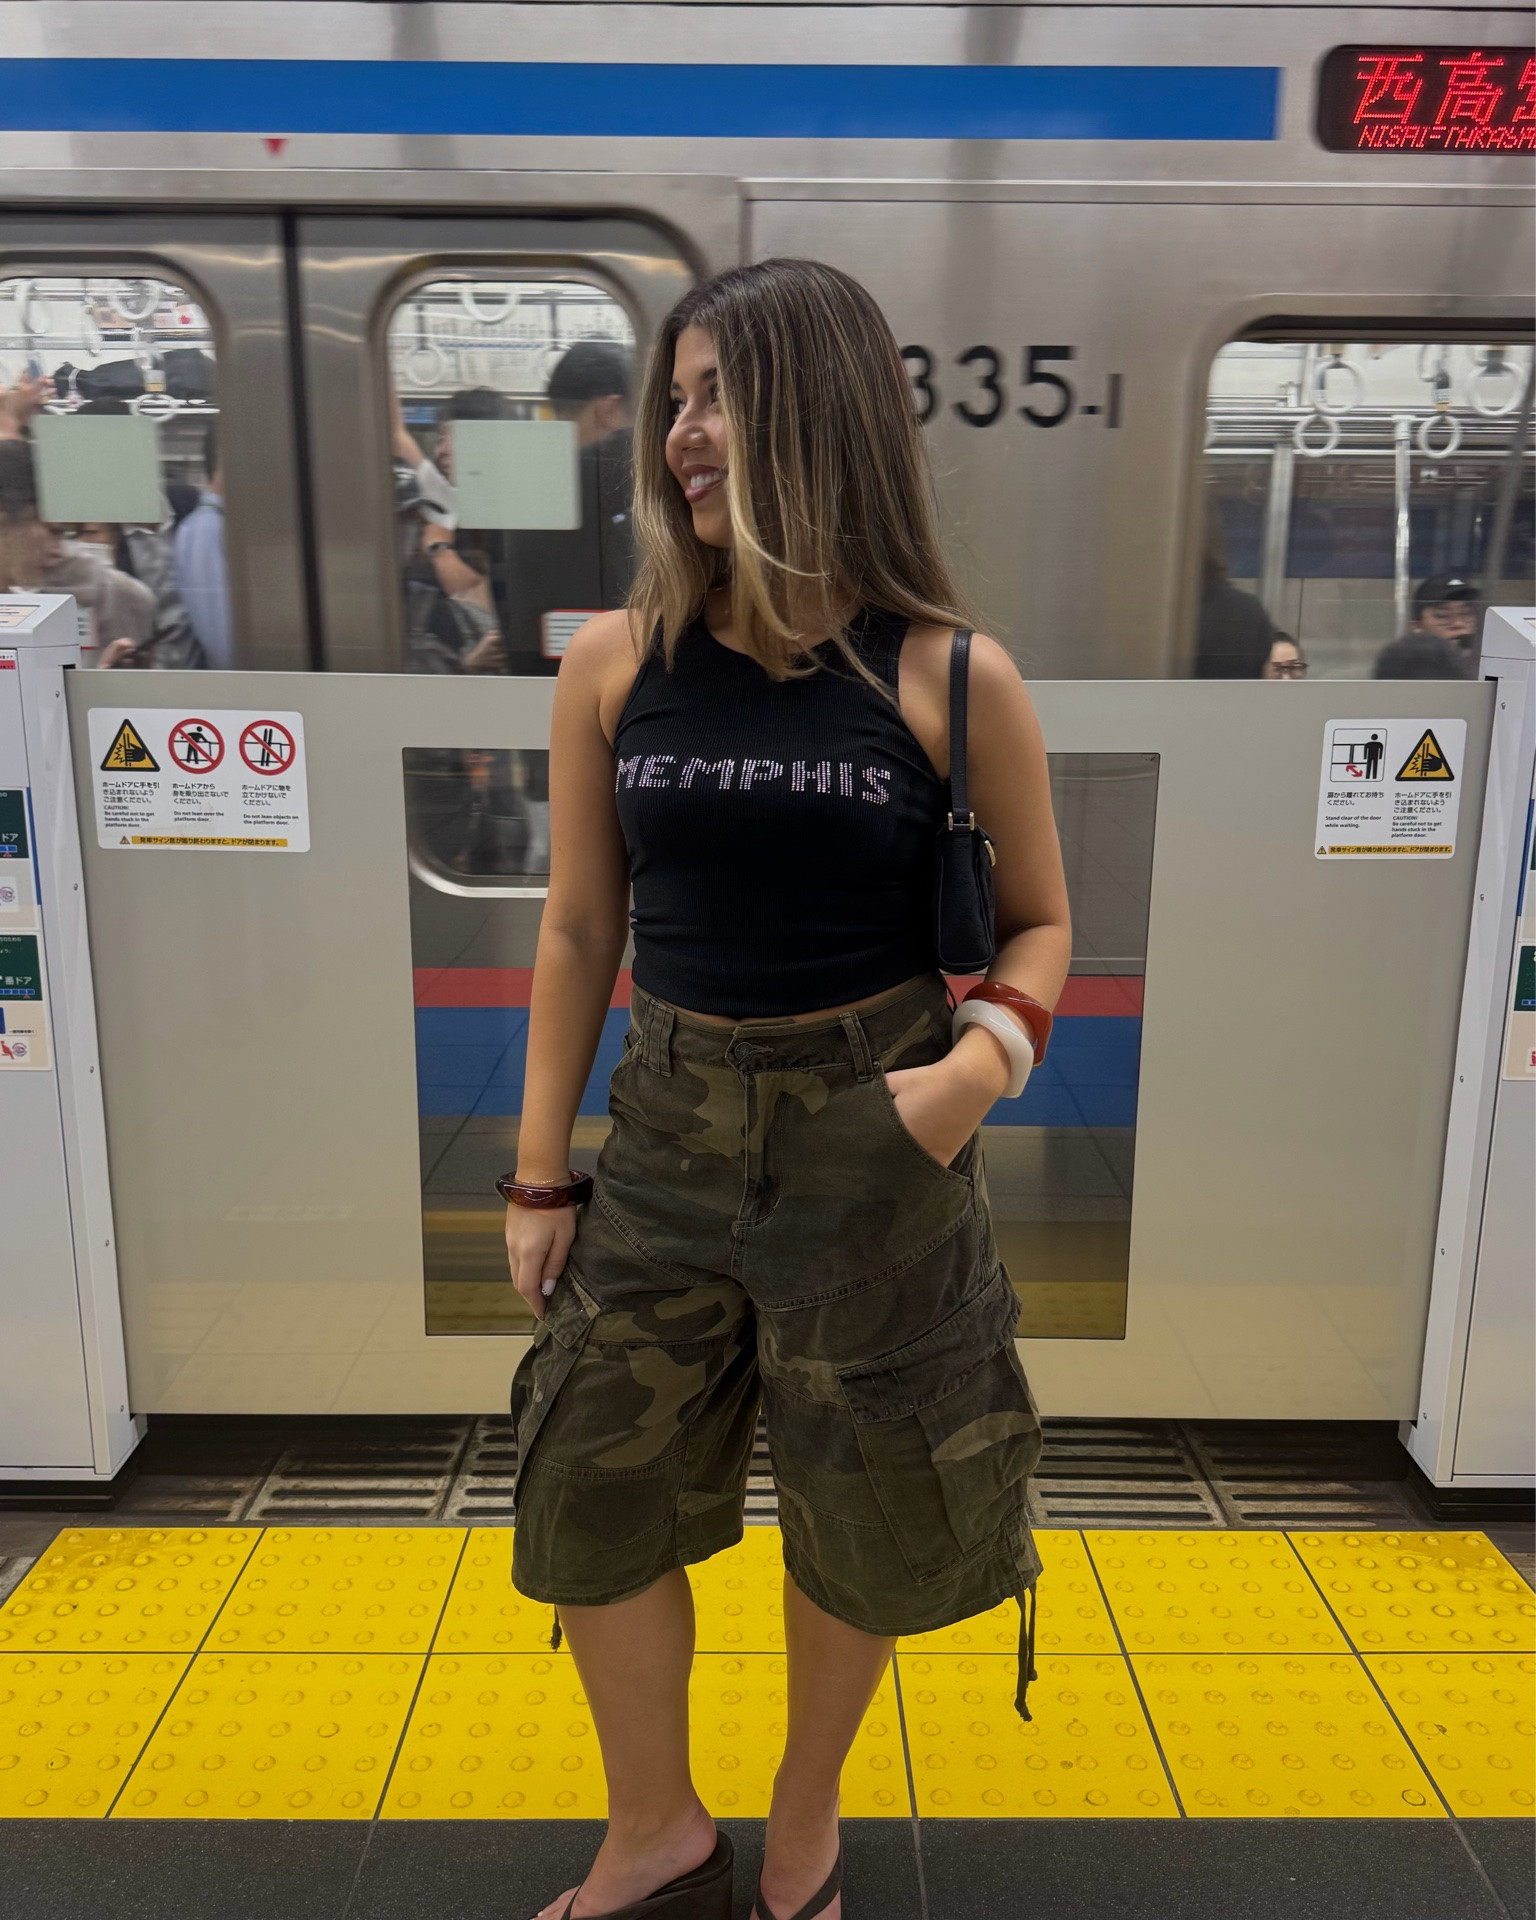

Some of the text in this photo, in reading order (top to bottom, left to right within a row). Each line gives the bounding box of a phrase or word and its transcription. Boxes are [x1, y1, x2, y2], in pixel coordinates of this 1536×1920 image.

[1357, 125, 1536, 149] NISHI-TAKASH
[616, 755, 891, 804] MEMPHIS
[241, 784, 291, 792] ホームドアに物を
[172, 790, 229, 798] 身を乗り出さないで
[2, 833, 18, 842] ドア
